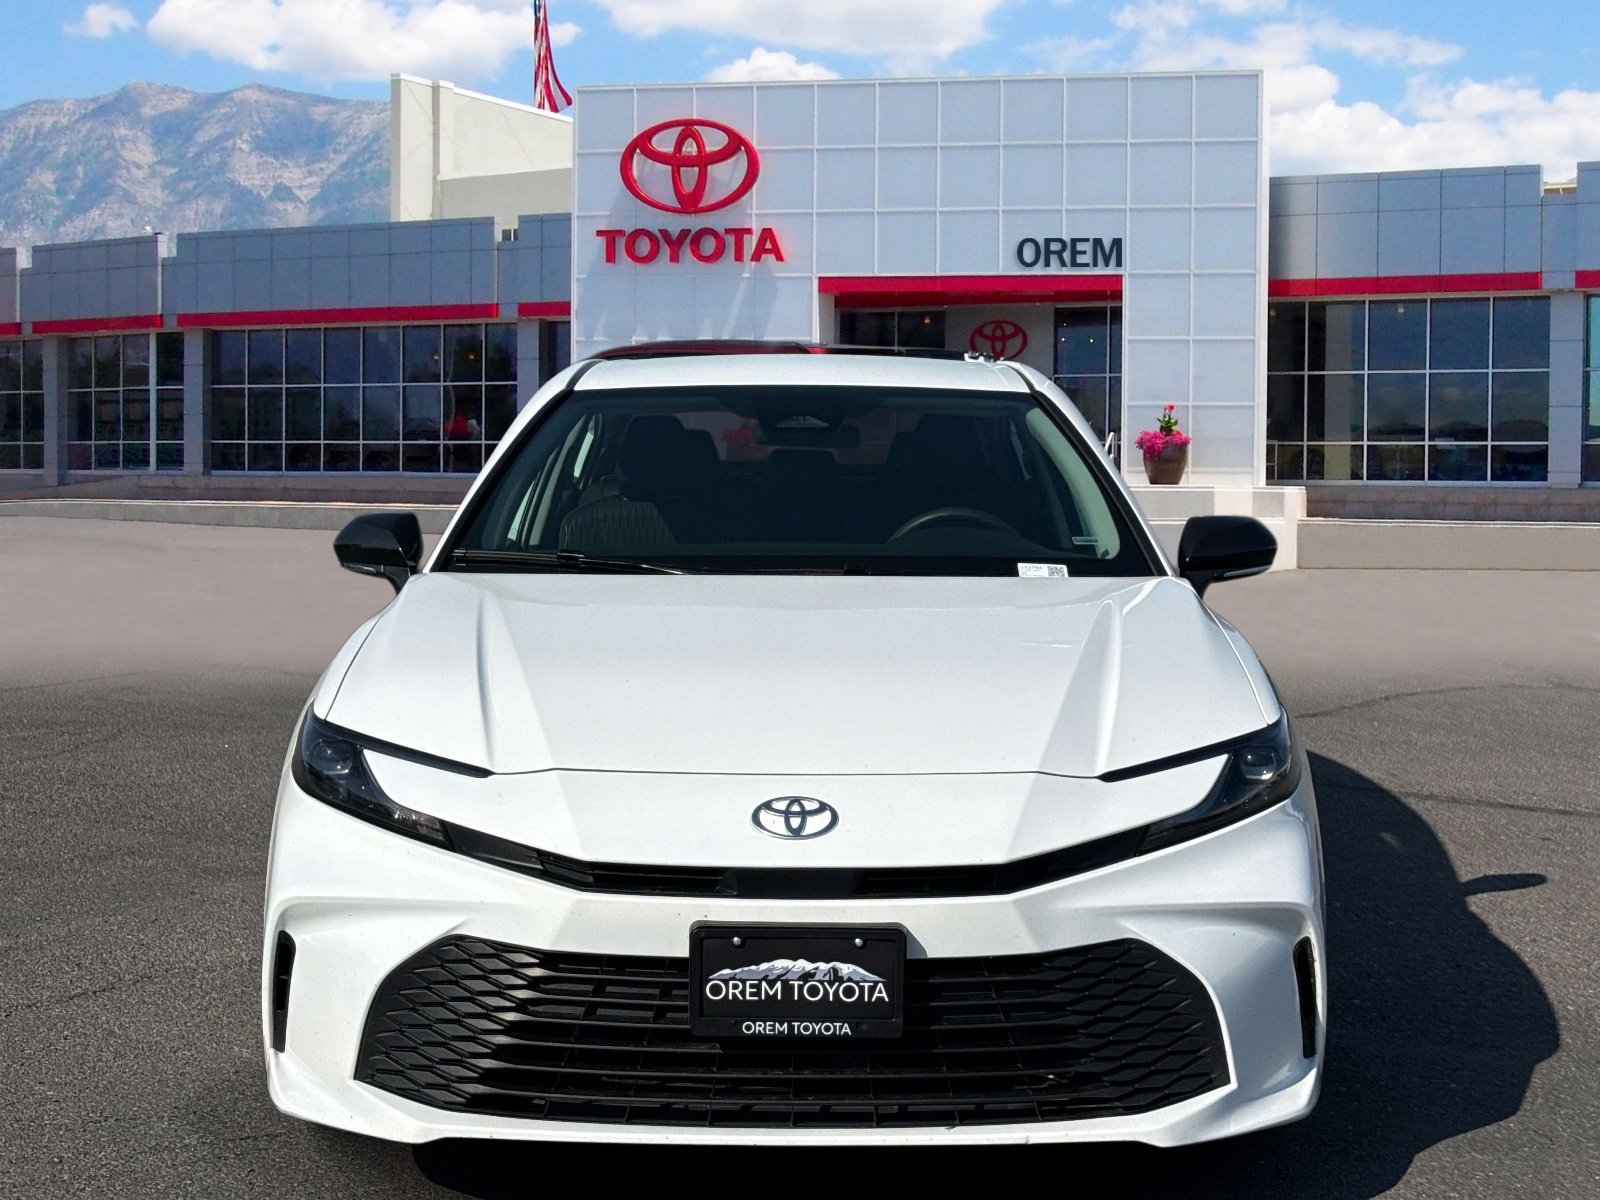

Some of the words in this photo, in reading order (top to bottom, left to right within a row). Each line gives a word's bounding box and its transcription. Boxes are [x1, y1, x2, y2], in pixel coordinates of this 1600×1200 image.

[596, 227, 785, 263] TOYOTA
[1016, 237, 1123, 269] OREM
[705, 980, 782, 1000] OREM
[789, 981, 889, 1002] TOYOTA
[742, 1021, 788, 1035] OREM
[792, 1022, 852, 1036] TOYOTA
